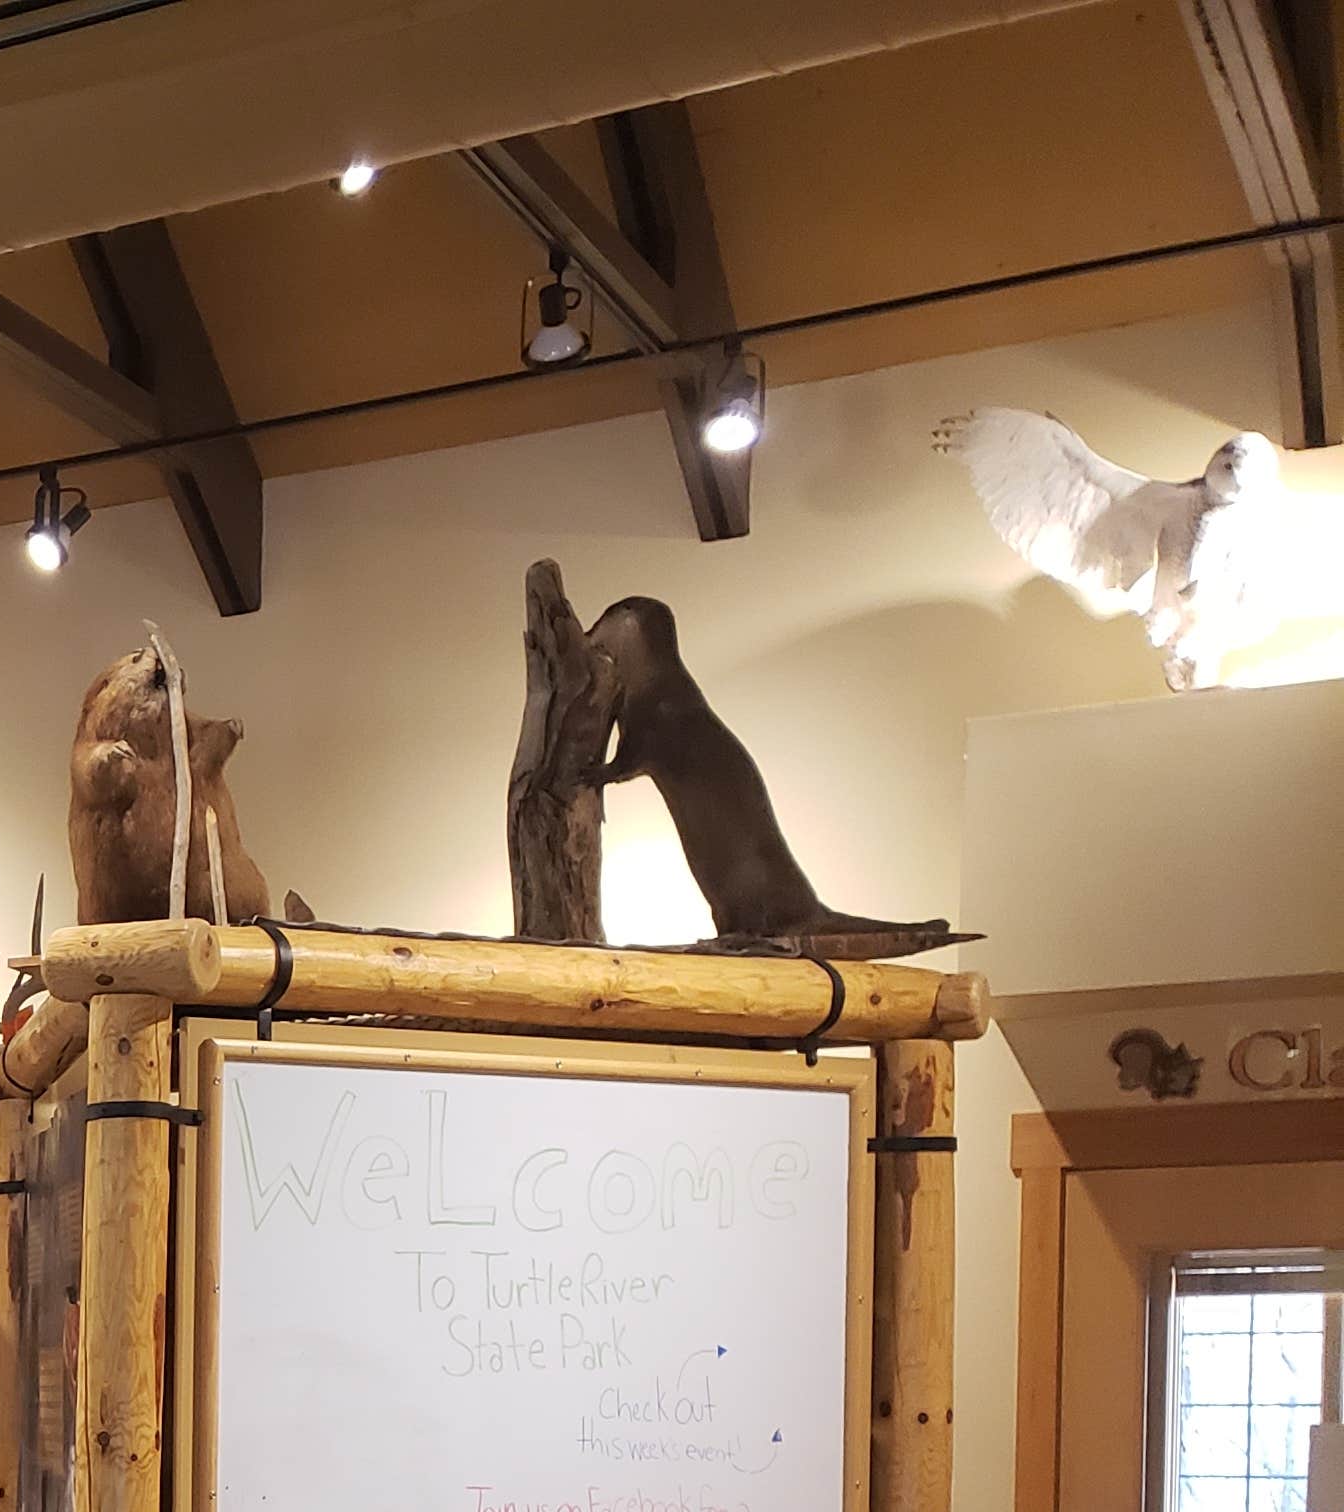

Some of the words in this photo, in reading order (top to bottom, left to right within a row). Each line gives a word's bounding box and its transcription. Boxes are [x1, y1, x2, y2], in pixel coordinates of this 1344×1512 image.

[395, 1250, 454, 1311] To
[471, 1250, 576, 1310] Turtle
[580, 1252, 675, 1307] River
[442, 1313, 546, 1377] State
[559, 1312, 631, 1367] Park
[598, 1376, 669, 1422] Check
[674, 1376, 716, 1425] out
[576, 1416, 623, 1460] this
